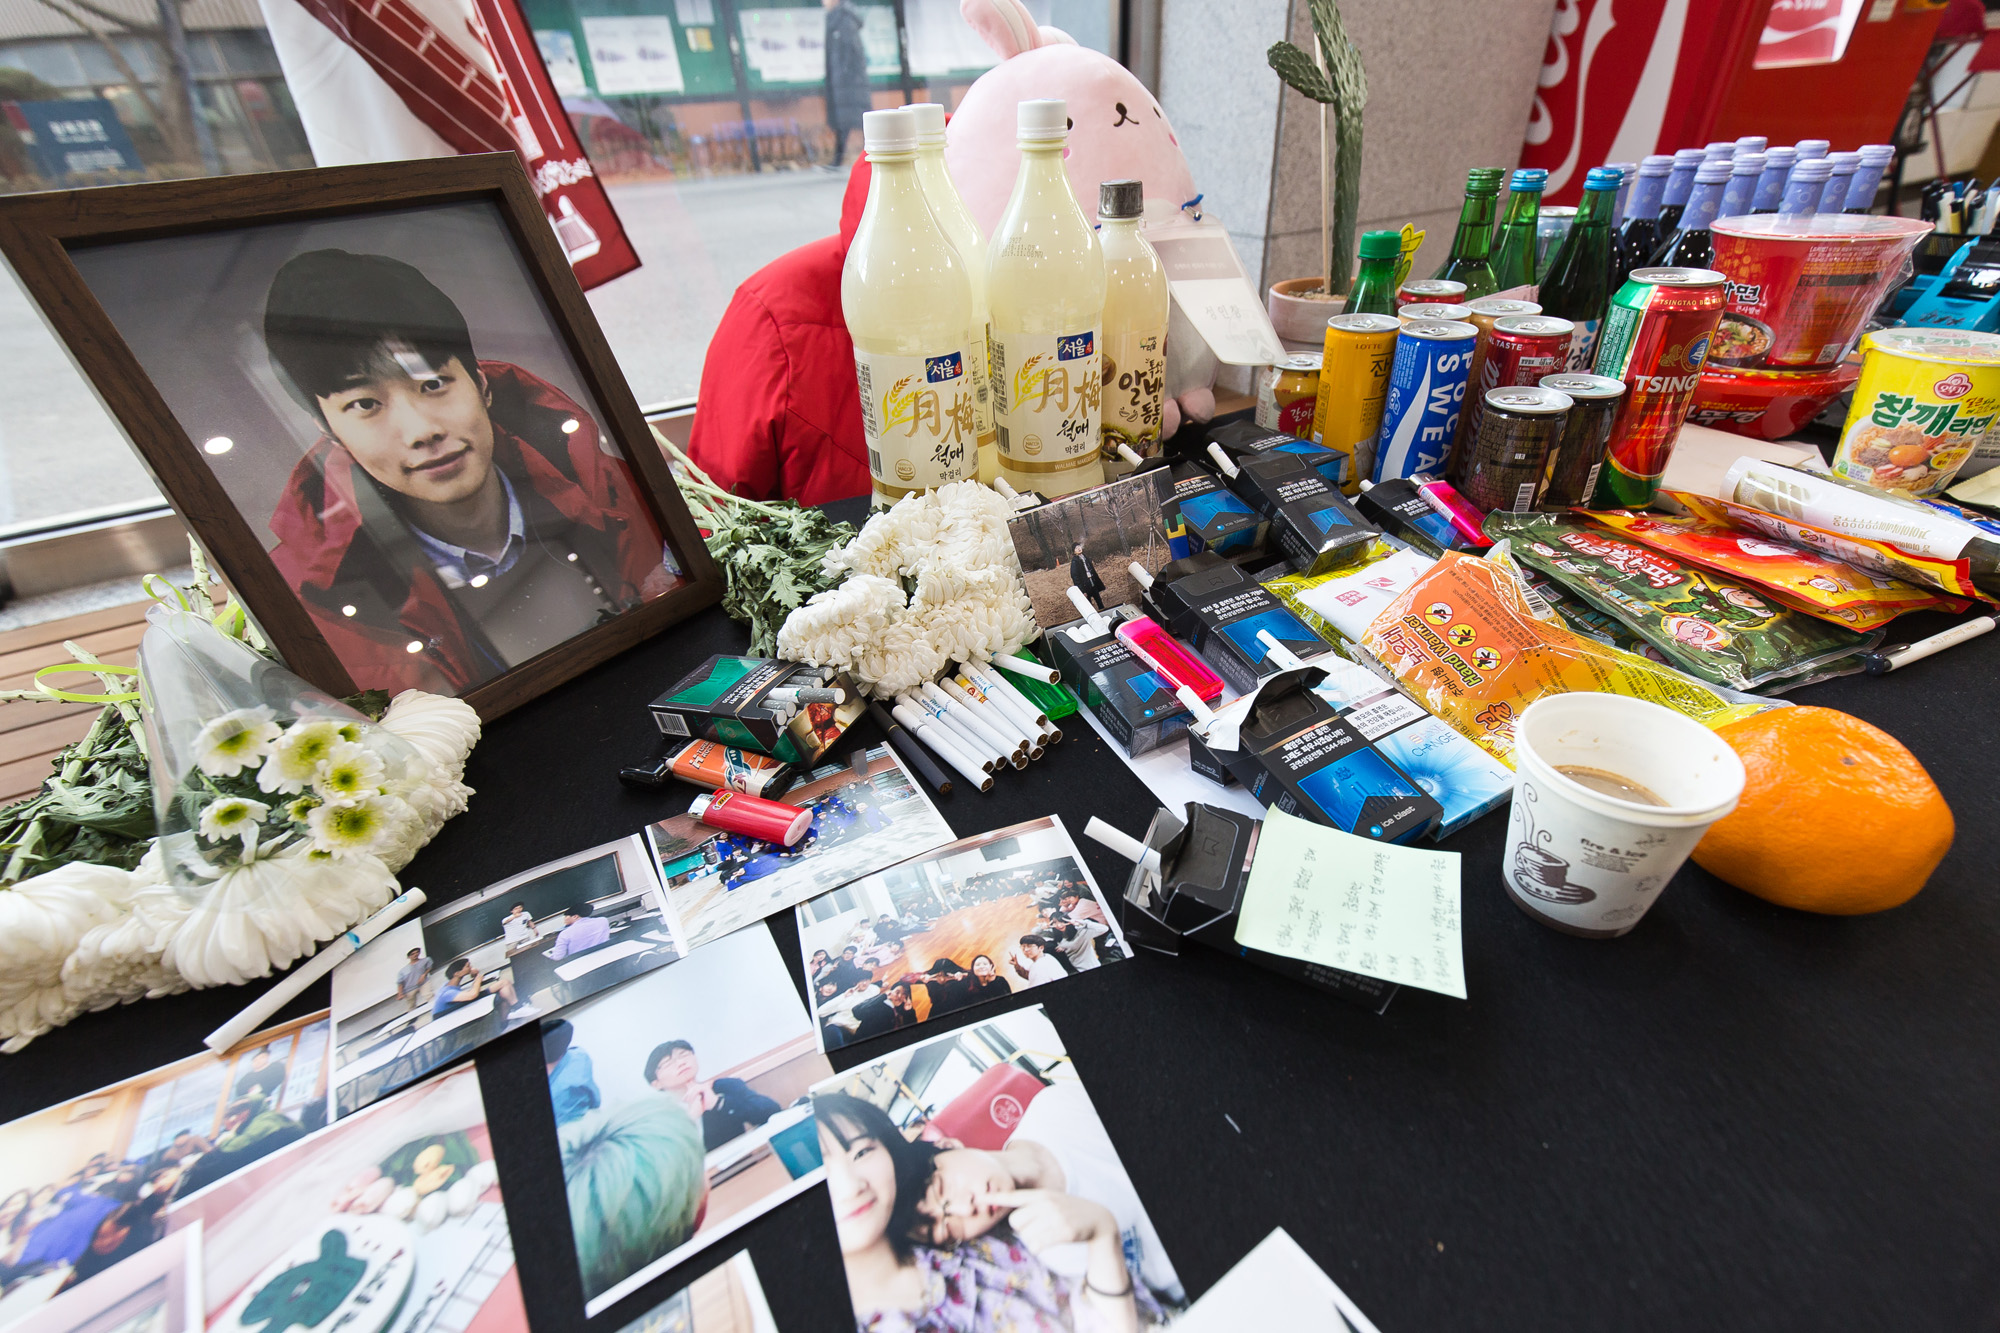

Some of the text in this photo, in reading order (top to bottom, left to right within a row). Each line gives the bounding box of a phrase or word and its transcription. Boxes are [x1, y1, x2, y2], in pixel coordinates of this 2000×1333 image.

[1660, 298, 1697, 306] TSINGTAO
[1062, 337, 1086, 358] 서울
[1496, 342, 1523, 351] TASTE
[930, 358, 955, 379] 서울
[1118, 369, 1164, 407] 알밤
[1635, 373, 1699, 394] TSING
[1939, 383, 1966, 396] 오뚜기
[903, 389, 974, 444] 月梅
[1141, 402, 1162, 426] 동동
[1414, 354, 1460, 473] SWEA
[1437, 350, 1475, 465] POCA
[1056, 419, 1089, 442] 월매
[930, 442, 964, 468] 월매
[1064, 441, 1086, 455] 막걸리
[939, 467, 962, 482] 막걸리
[1244, 598, 1270, 612] 1544-9030
[1381, 627, 1431, 667] 보온대
[1403, 615, 1450, 658] Warmer
[1430, 666, 1465, 698] 주머니형
[1443, 653, 1483, 687] Hand
[1354, 703, 1389, 722] 부모의 흡연은
[1363, 711, 1415, 737] 연상담전화 1544-9030
[1367, 715, 1384, 728] 건강을
[1281, 726, 1345, 764] 그래도 피우시겠습니까?
[1282, 723, 1331, 753] 폐암의 원인 흡연!
[1411, 732, 1458, 758] CHANGE
[1287, 733, 1353, 771] 금연상담전화 1544-9030
[717, 792, 734, 807] BIC
[1379, 803, 1417, 828] ice blast
[1580, 838, 1605, 851] fire
